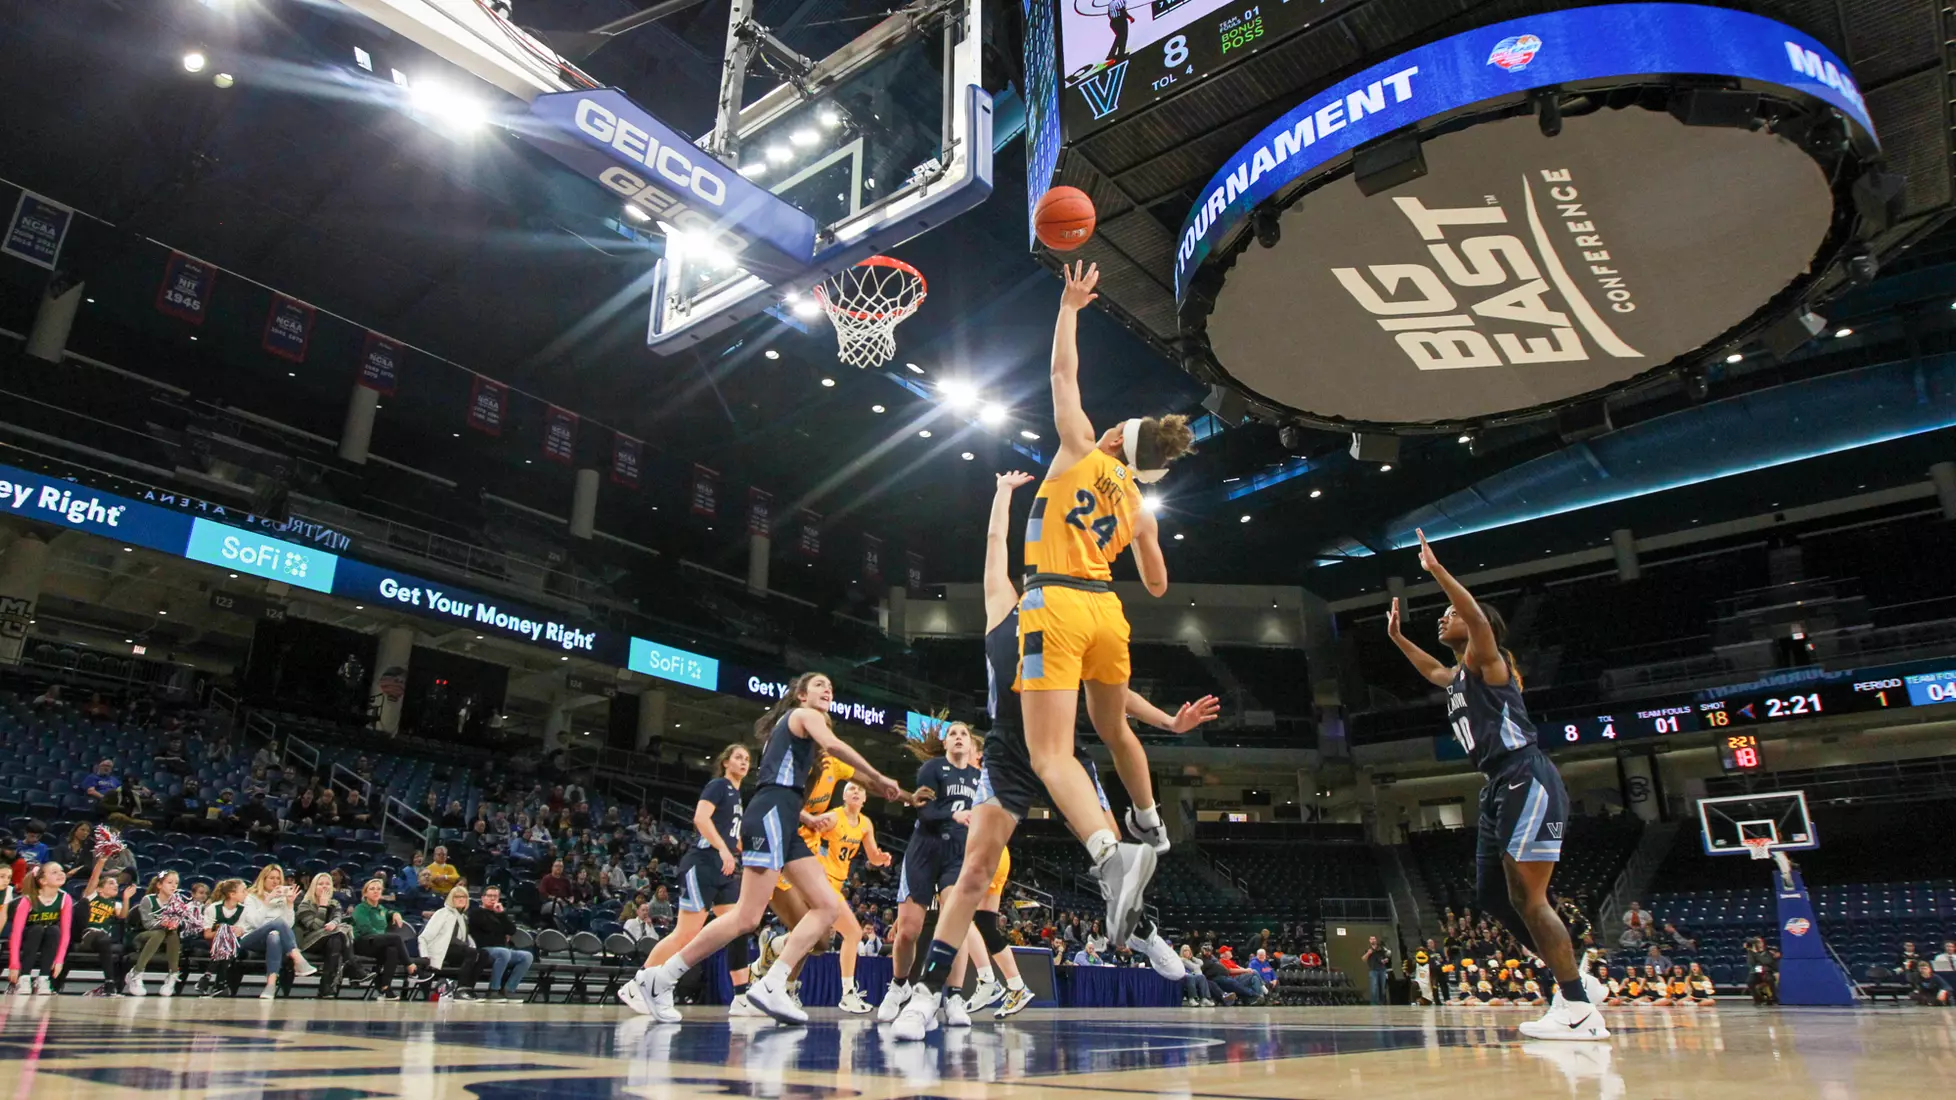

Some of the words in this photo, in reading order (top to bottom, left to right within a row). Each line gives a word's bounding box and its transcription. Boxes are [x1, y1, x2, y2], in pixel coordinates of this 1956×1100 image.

[1219, 16, 1238, 28] TEAM
[1244, 5, 1261, 20] 01
[1219, 19, 1242, 34] FOULS
[1221, 16, 1263, 43] BONUS
[1222, 25, 1265, 54] POSS
[1163, 34, 1189, 69] 8
[1151, 76, 1178, 92] TOL
[1185, 64, 1194, 76] 4
[575, 98, 727, 207] GEICO
[1178, 65, 1419, 274] TOURNAMENT
[22, 216, 56, 236] NCAA
[1540, 168, 1637, 314] CONFERENCE
[178, 278, 197, 290] NIT
[1391, 196, 1590, 365] EAST
[165, 290, 201, 311] 1945
[276, 316, 303, 332] NCAA
[1330, 263, 1504, 371] BIG
[1065, 488, 1118, 551] 24
[221, 535, 281, 571] SoFi
[215, 596, 233, 609] 123
[379, 577, 422, 606] Get
[426, 588, 473, 619] Your
[475, 602, 544, 641] Money
[266, 608, 284, 620] 124
[649, 650, 685, 676] SoFi
[747, 676, 775, 698] Get
[1853, 678, 1903, 692] PERIOD
[1927, 682, 1956, 702] 04
[1700, 701, 1726, 711] SHOT
[1764, 693, 1823, 718] 2:21
[1874, 691, 1889, 707] 1
[1598, 715, 1615, 723] TOL
[1637, 708, 1662, 720] TEAM
[1662, 705, 1692, 717] FOULS
[1705, 710, 1731, 727] 18
[1564, 724, 1579, 742] 8
[1602, 723, 1616, 740] 4
[1655, 715, 1681, 734] 01
[1728, 735, 1757, 749] 2:21
[1735, 748, 1759, 768] 18
